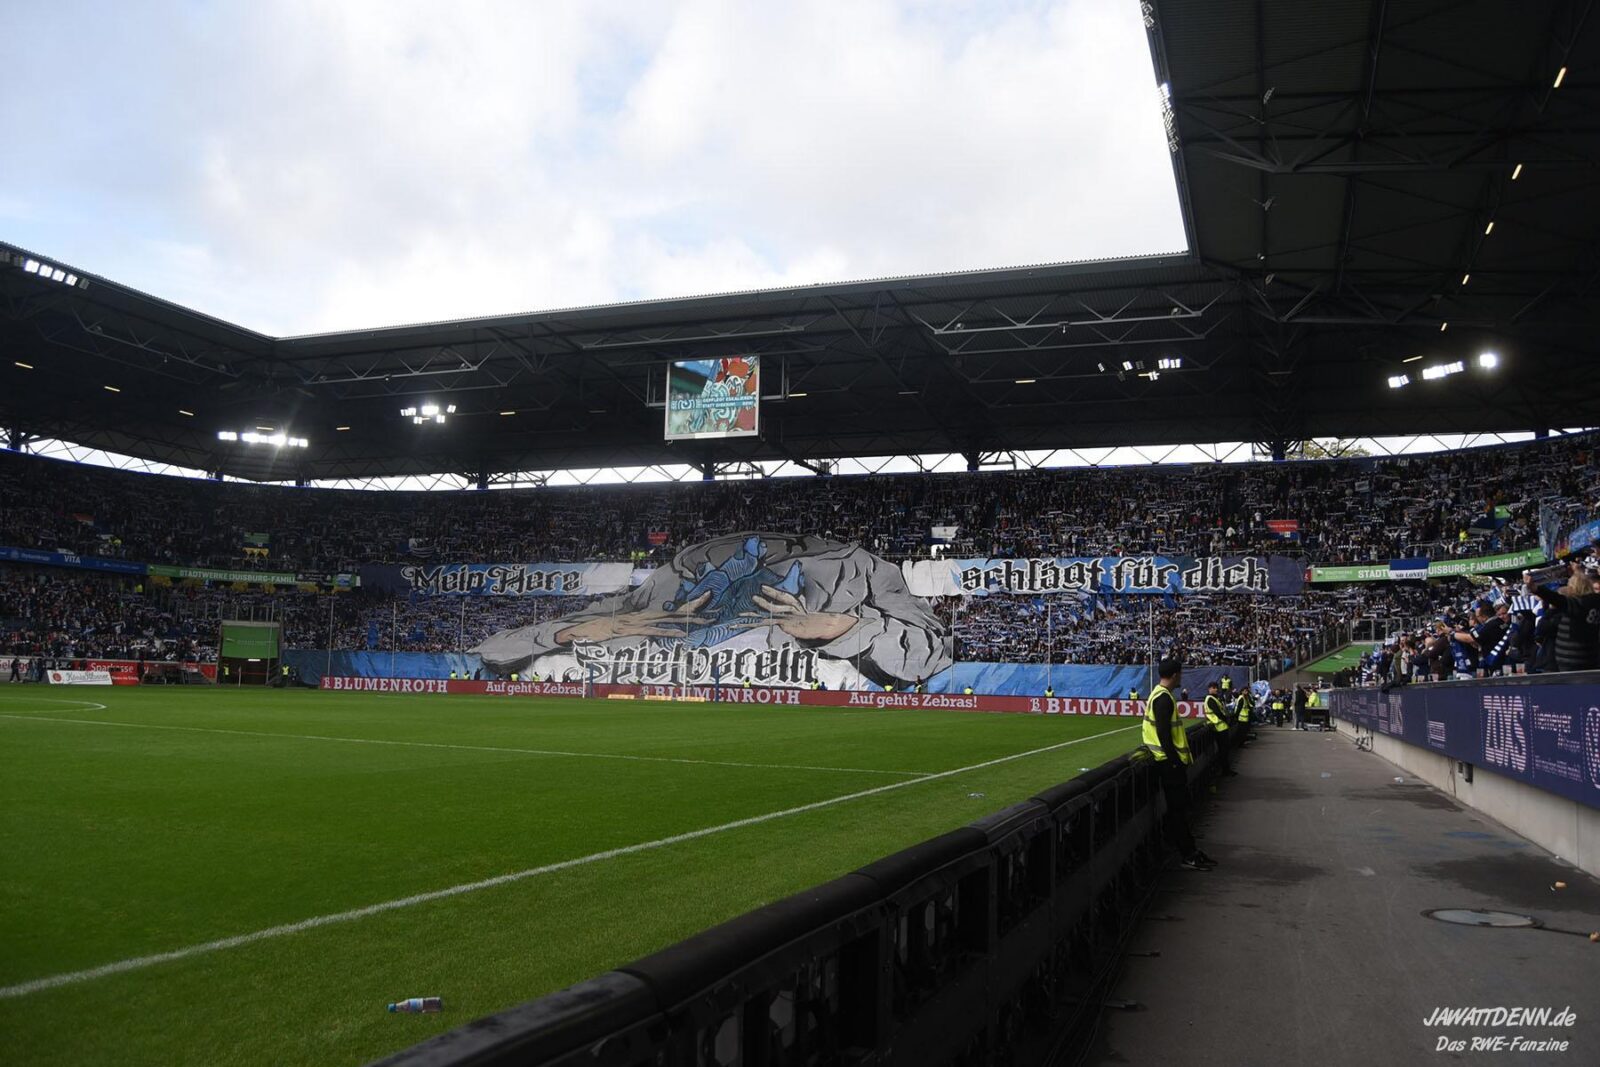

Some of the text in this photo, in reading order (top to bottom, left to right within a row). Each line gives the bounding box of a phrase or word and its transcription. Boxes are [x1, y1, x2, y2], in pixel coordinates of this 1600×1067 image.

[64, 554, 82, 564] VITA
[1357, 568, 1390, 580] STADT
[1428, 555, 1526, 575] UISBURG-FAMILIENBLOCK
[401, 564, 487, 595] Mein
[958, 556, 1269, 593] schlägt für dich
[572, 639, 819, 684] Spielverein
[333, 676, 448, 693] BLUMENROTH
[485, 681, 507, 693] Auf
[507, 682, 541, 696] geht's
[655, 685, 800, 704] BLUMENROTH
[848, 691, 978, 709] Auf geht's Zebras!
[1046, 697, 1205, 719] BLUMENOT
